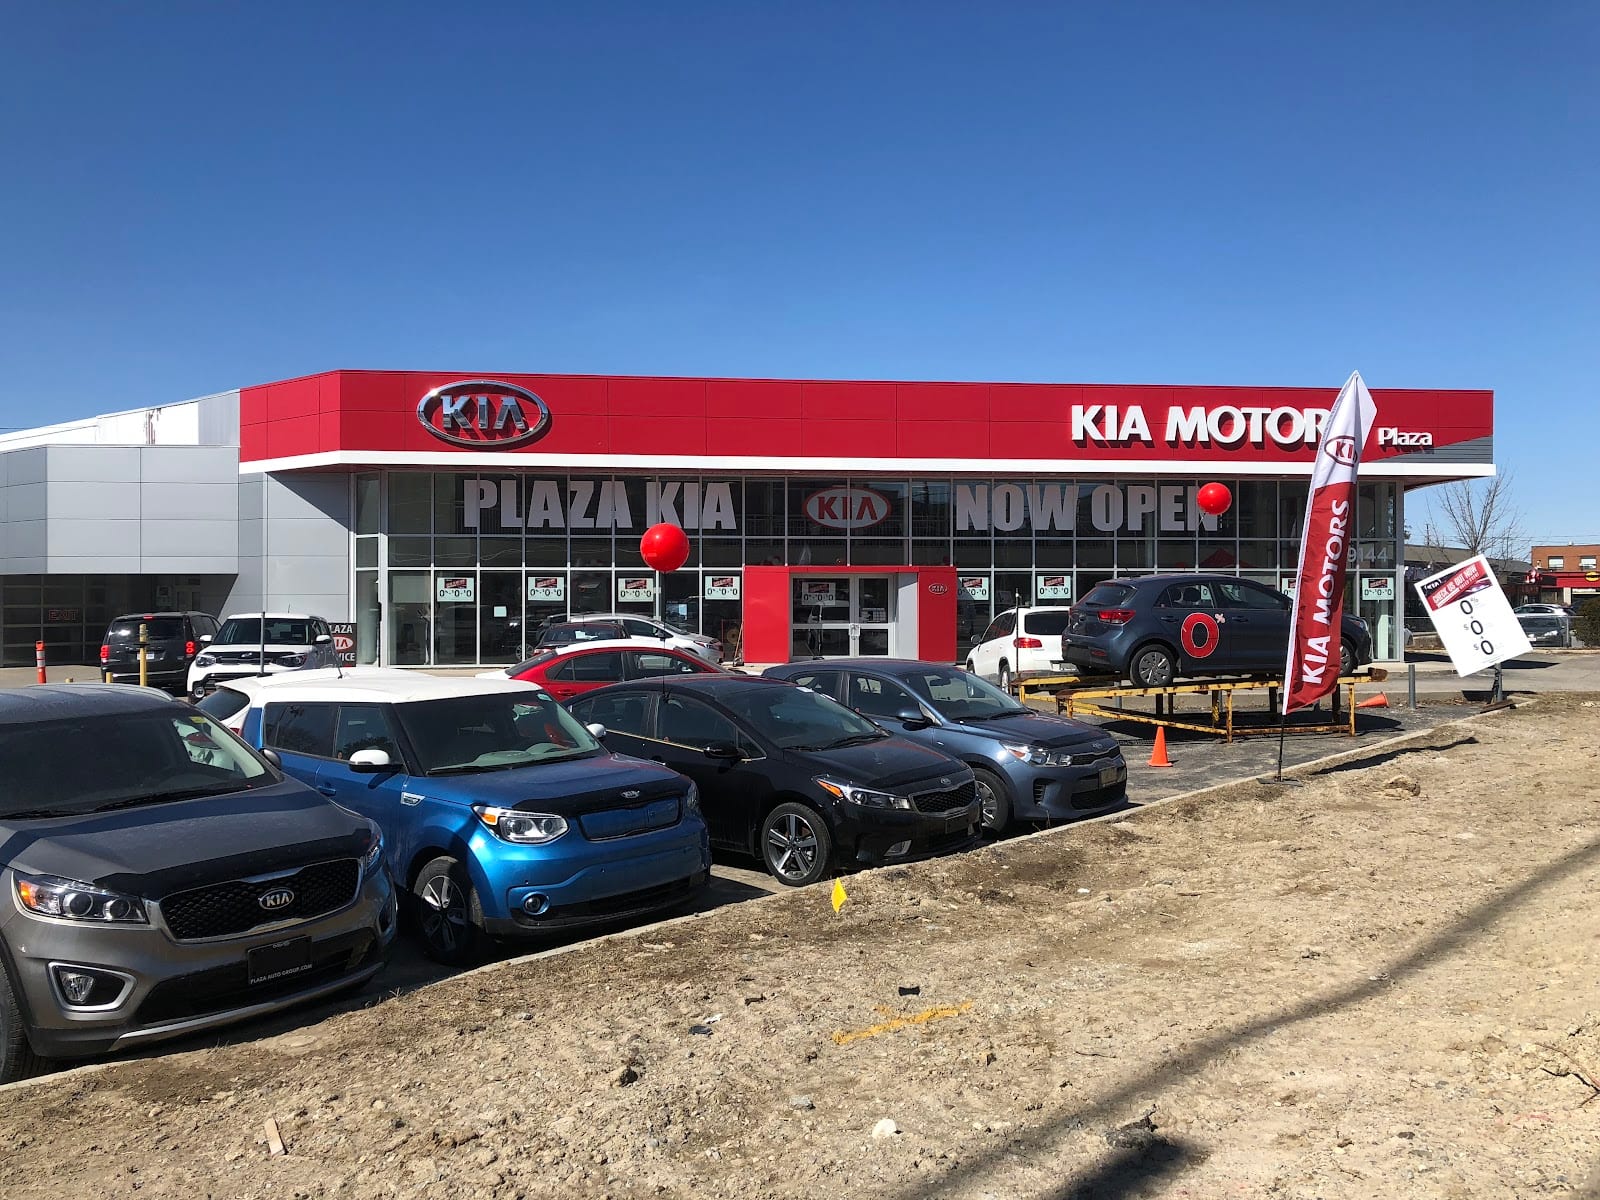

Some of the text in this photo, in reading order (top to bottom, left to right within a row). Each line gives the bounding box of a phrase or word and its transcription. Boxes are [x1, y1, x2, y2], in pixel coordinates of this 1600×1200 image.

[441, 394, 526, 430] KIA
[1071, 405, 1331, 443] KIA MOTOR
[1377, 427, 1433, 446] Plaza
[464, 479, 737, 529] PLAZA KIA
[818, 496, 878, 520] KIA
[956, 484, 1080, 531] NOW
[1347, 547, 1388, 562] 9144
[1302, 499, 1350, 684] KIA MOTORS
[329, 624, 353, 633] LAZA
[266, 892, 290, 907] KIA
[250, 975, 266, 984] PLAZA
